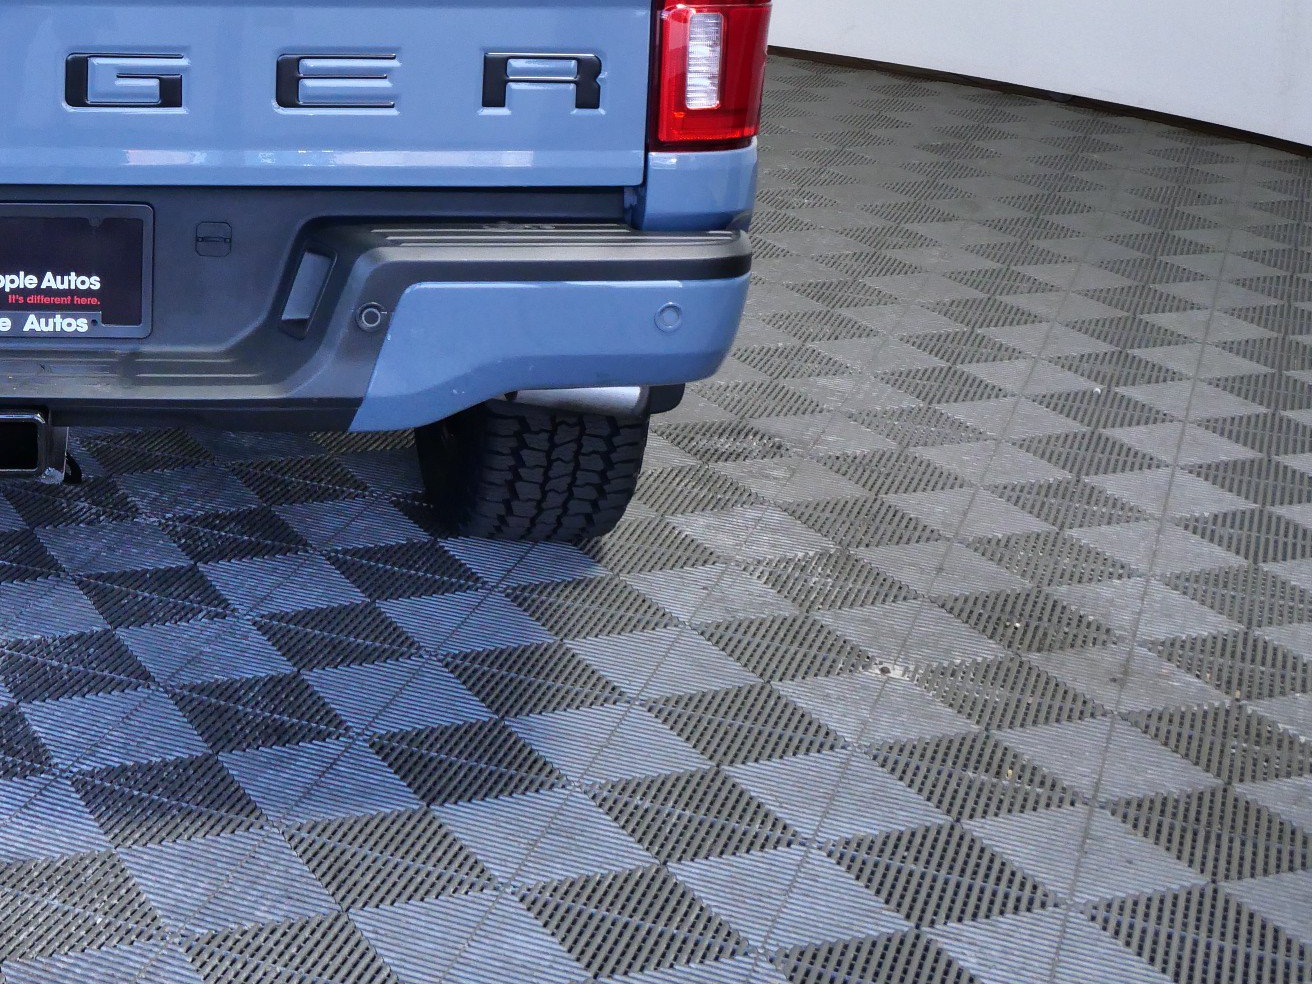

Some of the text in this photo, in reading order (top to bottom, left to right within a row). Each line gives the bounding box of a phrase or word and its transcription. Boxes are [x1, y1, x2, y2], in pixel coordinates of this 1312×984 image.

[40, 271, 101, 290] Autos
[8, 294, 101, 305] It's different here.
[22, 314, 89, 333] Autos
